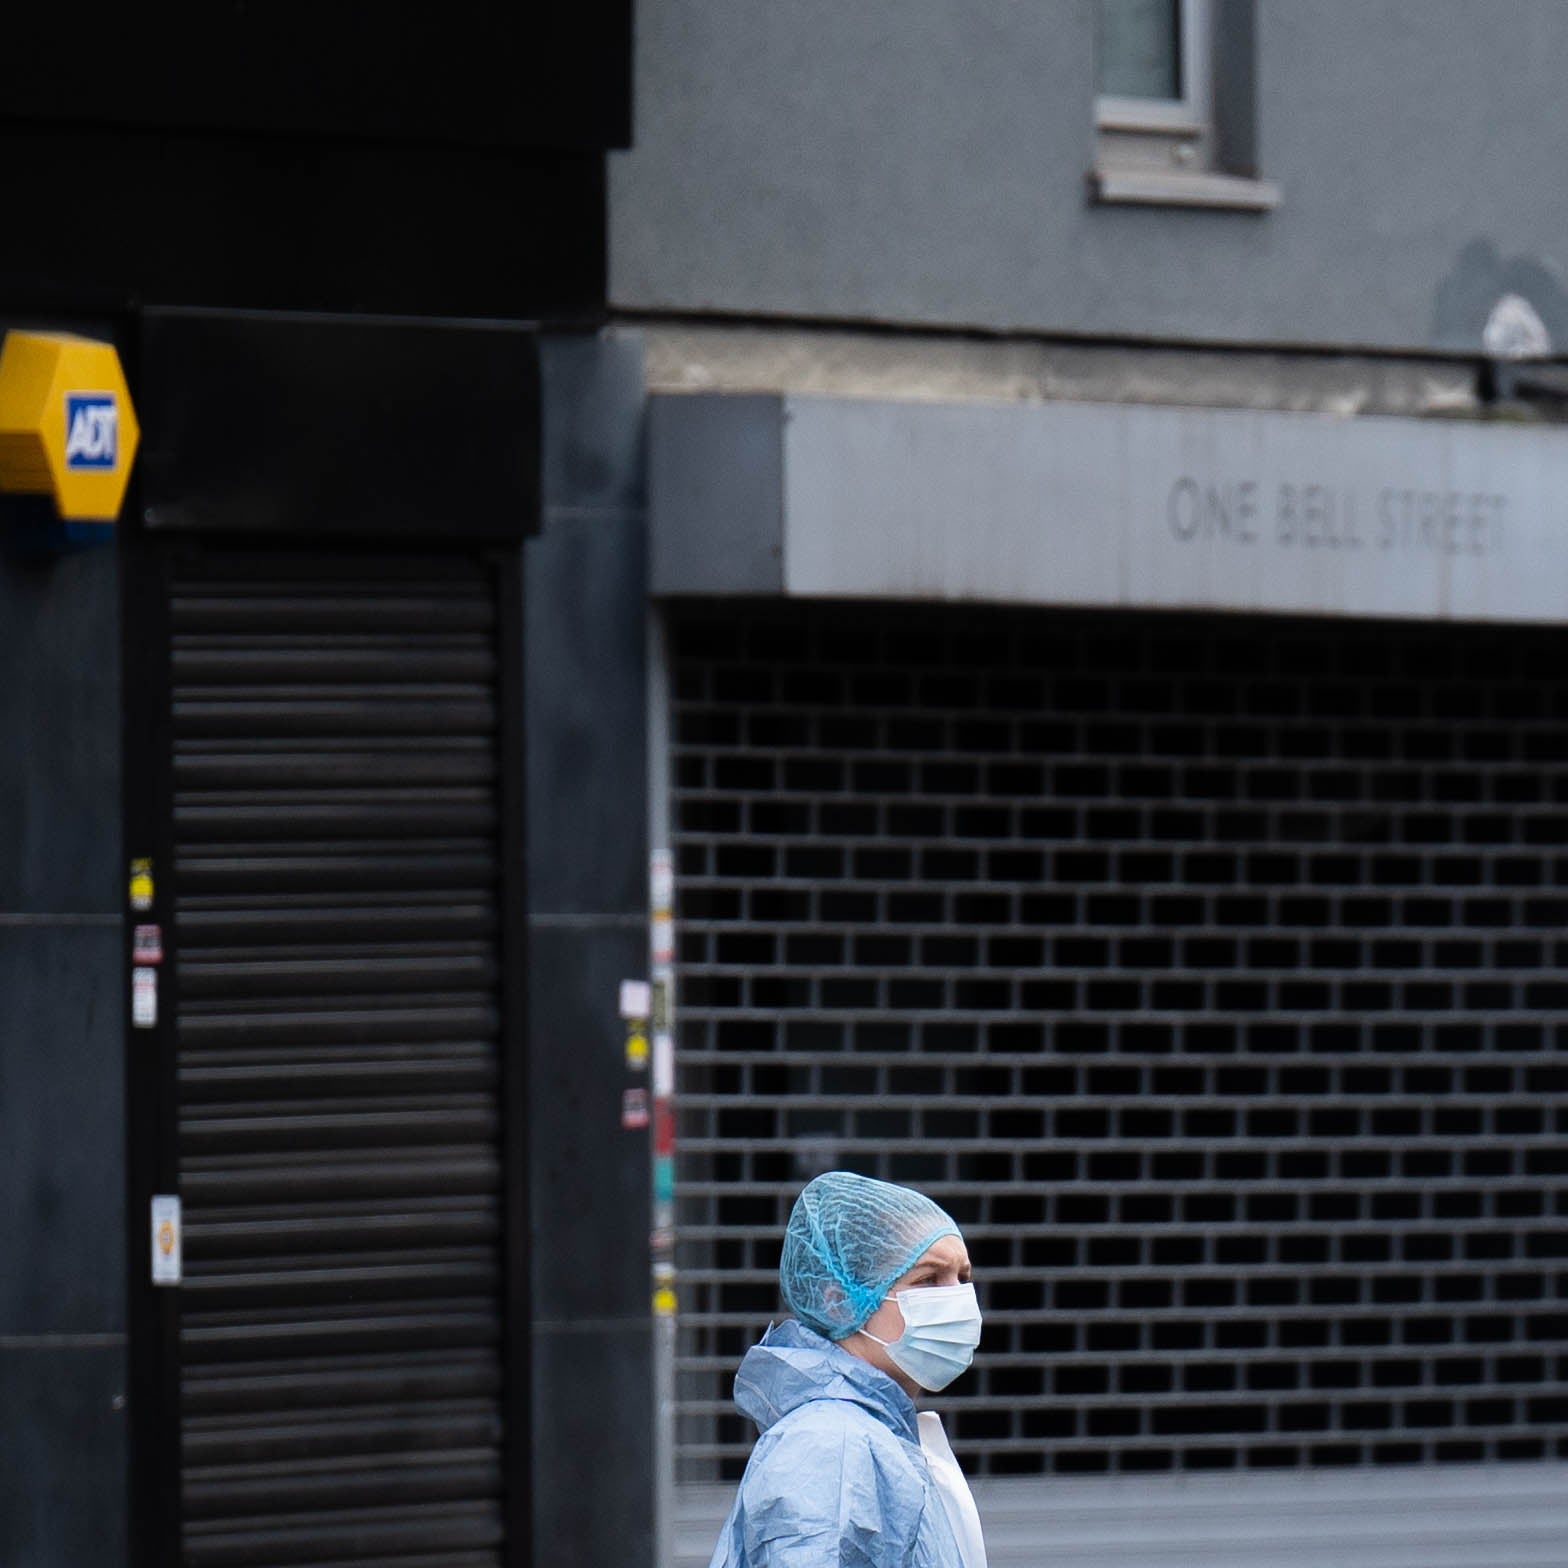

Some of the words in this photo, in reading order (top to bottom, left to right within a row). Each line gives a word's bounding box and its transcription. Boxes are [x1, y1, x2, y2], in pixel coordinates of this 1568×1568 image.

[66, 404, 117, 461] ADT
[1166, 475, 1260, 544] ONE
[1277, 482, 1365, 548] BELL
[1375, 487, 1508, 556] STREET
